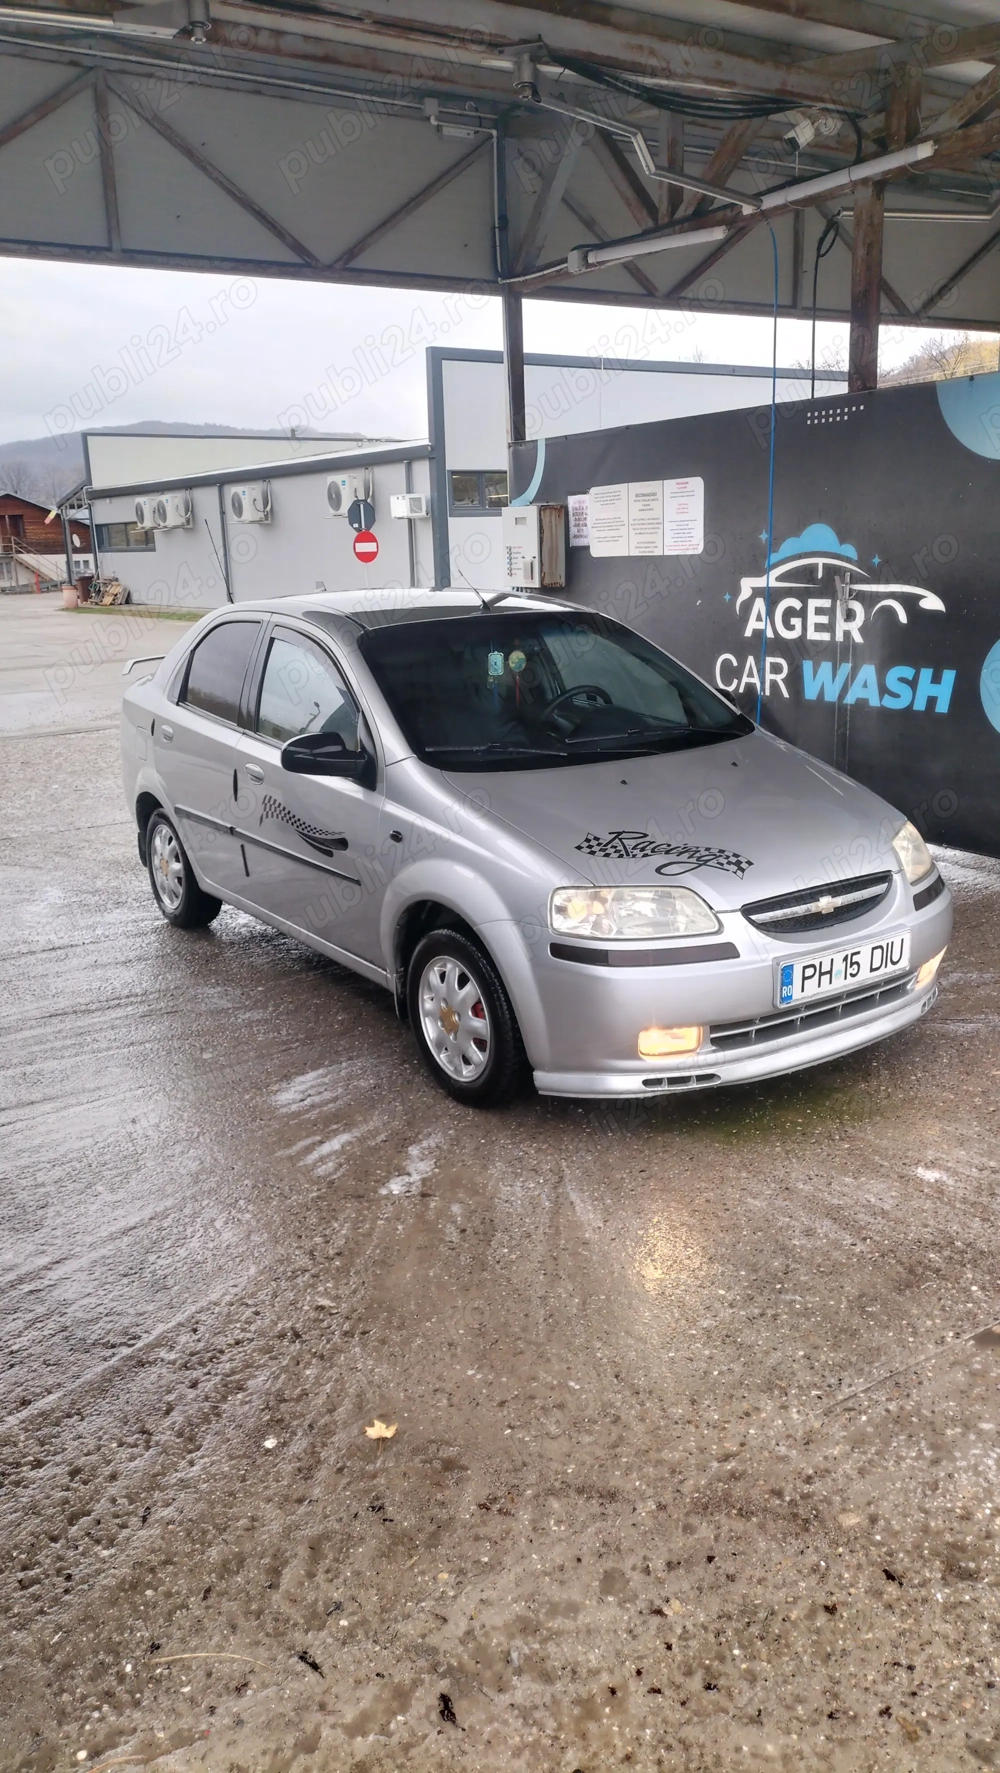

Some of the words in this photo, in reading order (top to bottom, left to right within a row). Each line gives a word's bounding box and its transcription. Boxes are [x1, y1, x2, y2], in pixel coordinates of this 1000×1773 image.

[744, 597, 865, 643] AGER
[715, 653, 790, 698] CAR
[802, 660, 957, 713] WASH
[602, 830, 731, 877] Racing
[801, 958, 834, 993] PH
[842, 951, 861, 981] 15
[869, 938, 904, 973] DIU
[782, 986, 793, 998] RO
